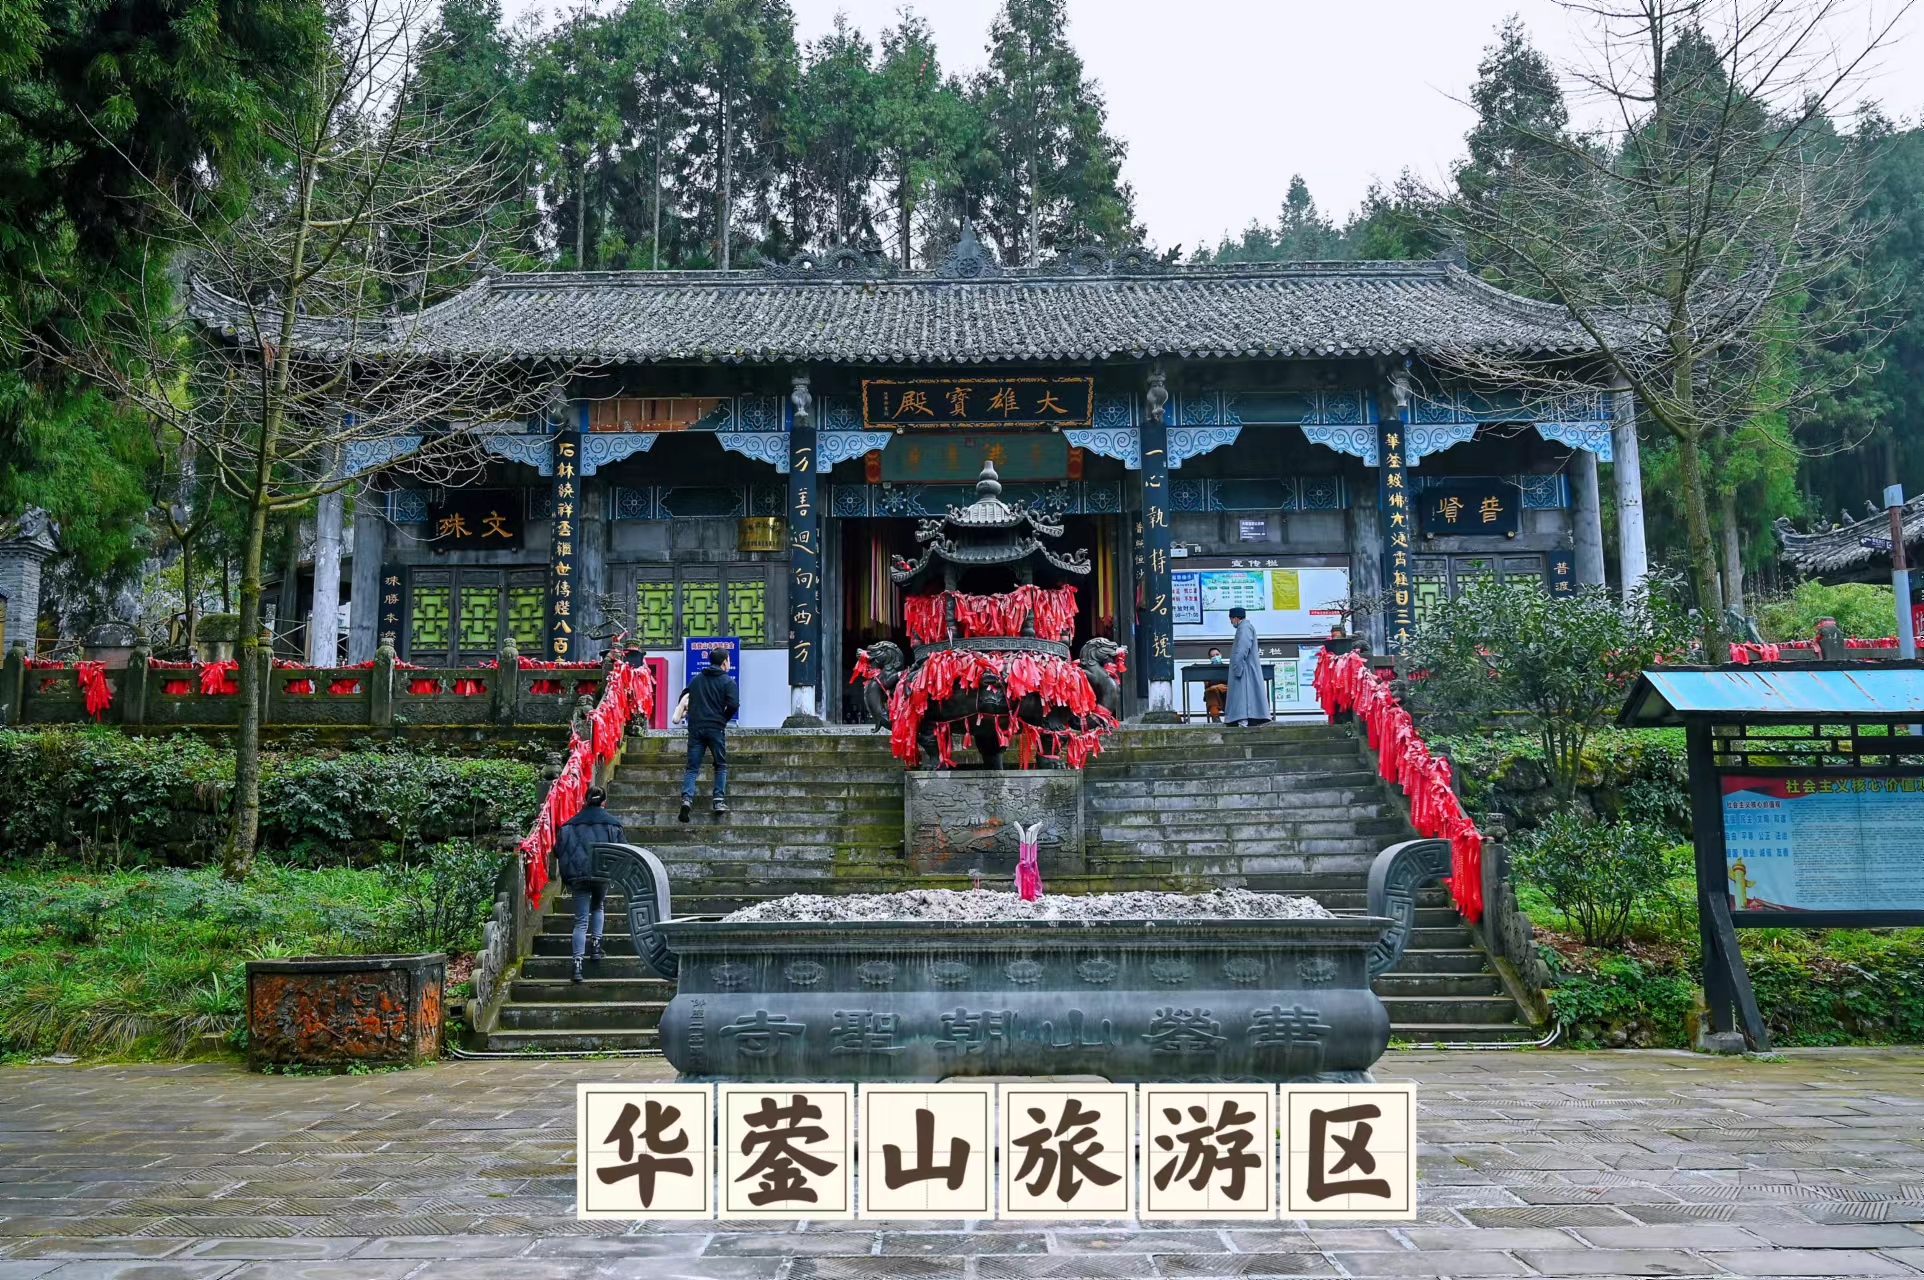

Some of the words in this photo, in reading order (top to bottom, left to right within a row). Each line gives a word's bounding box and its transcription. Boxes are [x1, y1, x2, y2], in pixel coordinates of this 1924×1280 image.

[892, 387, 1069, 419] 大雄寶殿
[1436, 495, 1503, 523] 普賢
[439, 511, 513, 538] 文殊
[1231, 559, 1279, 568] 宣传栏
